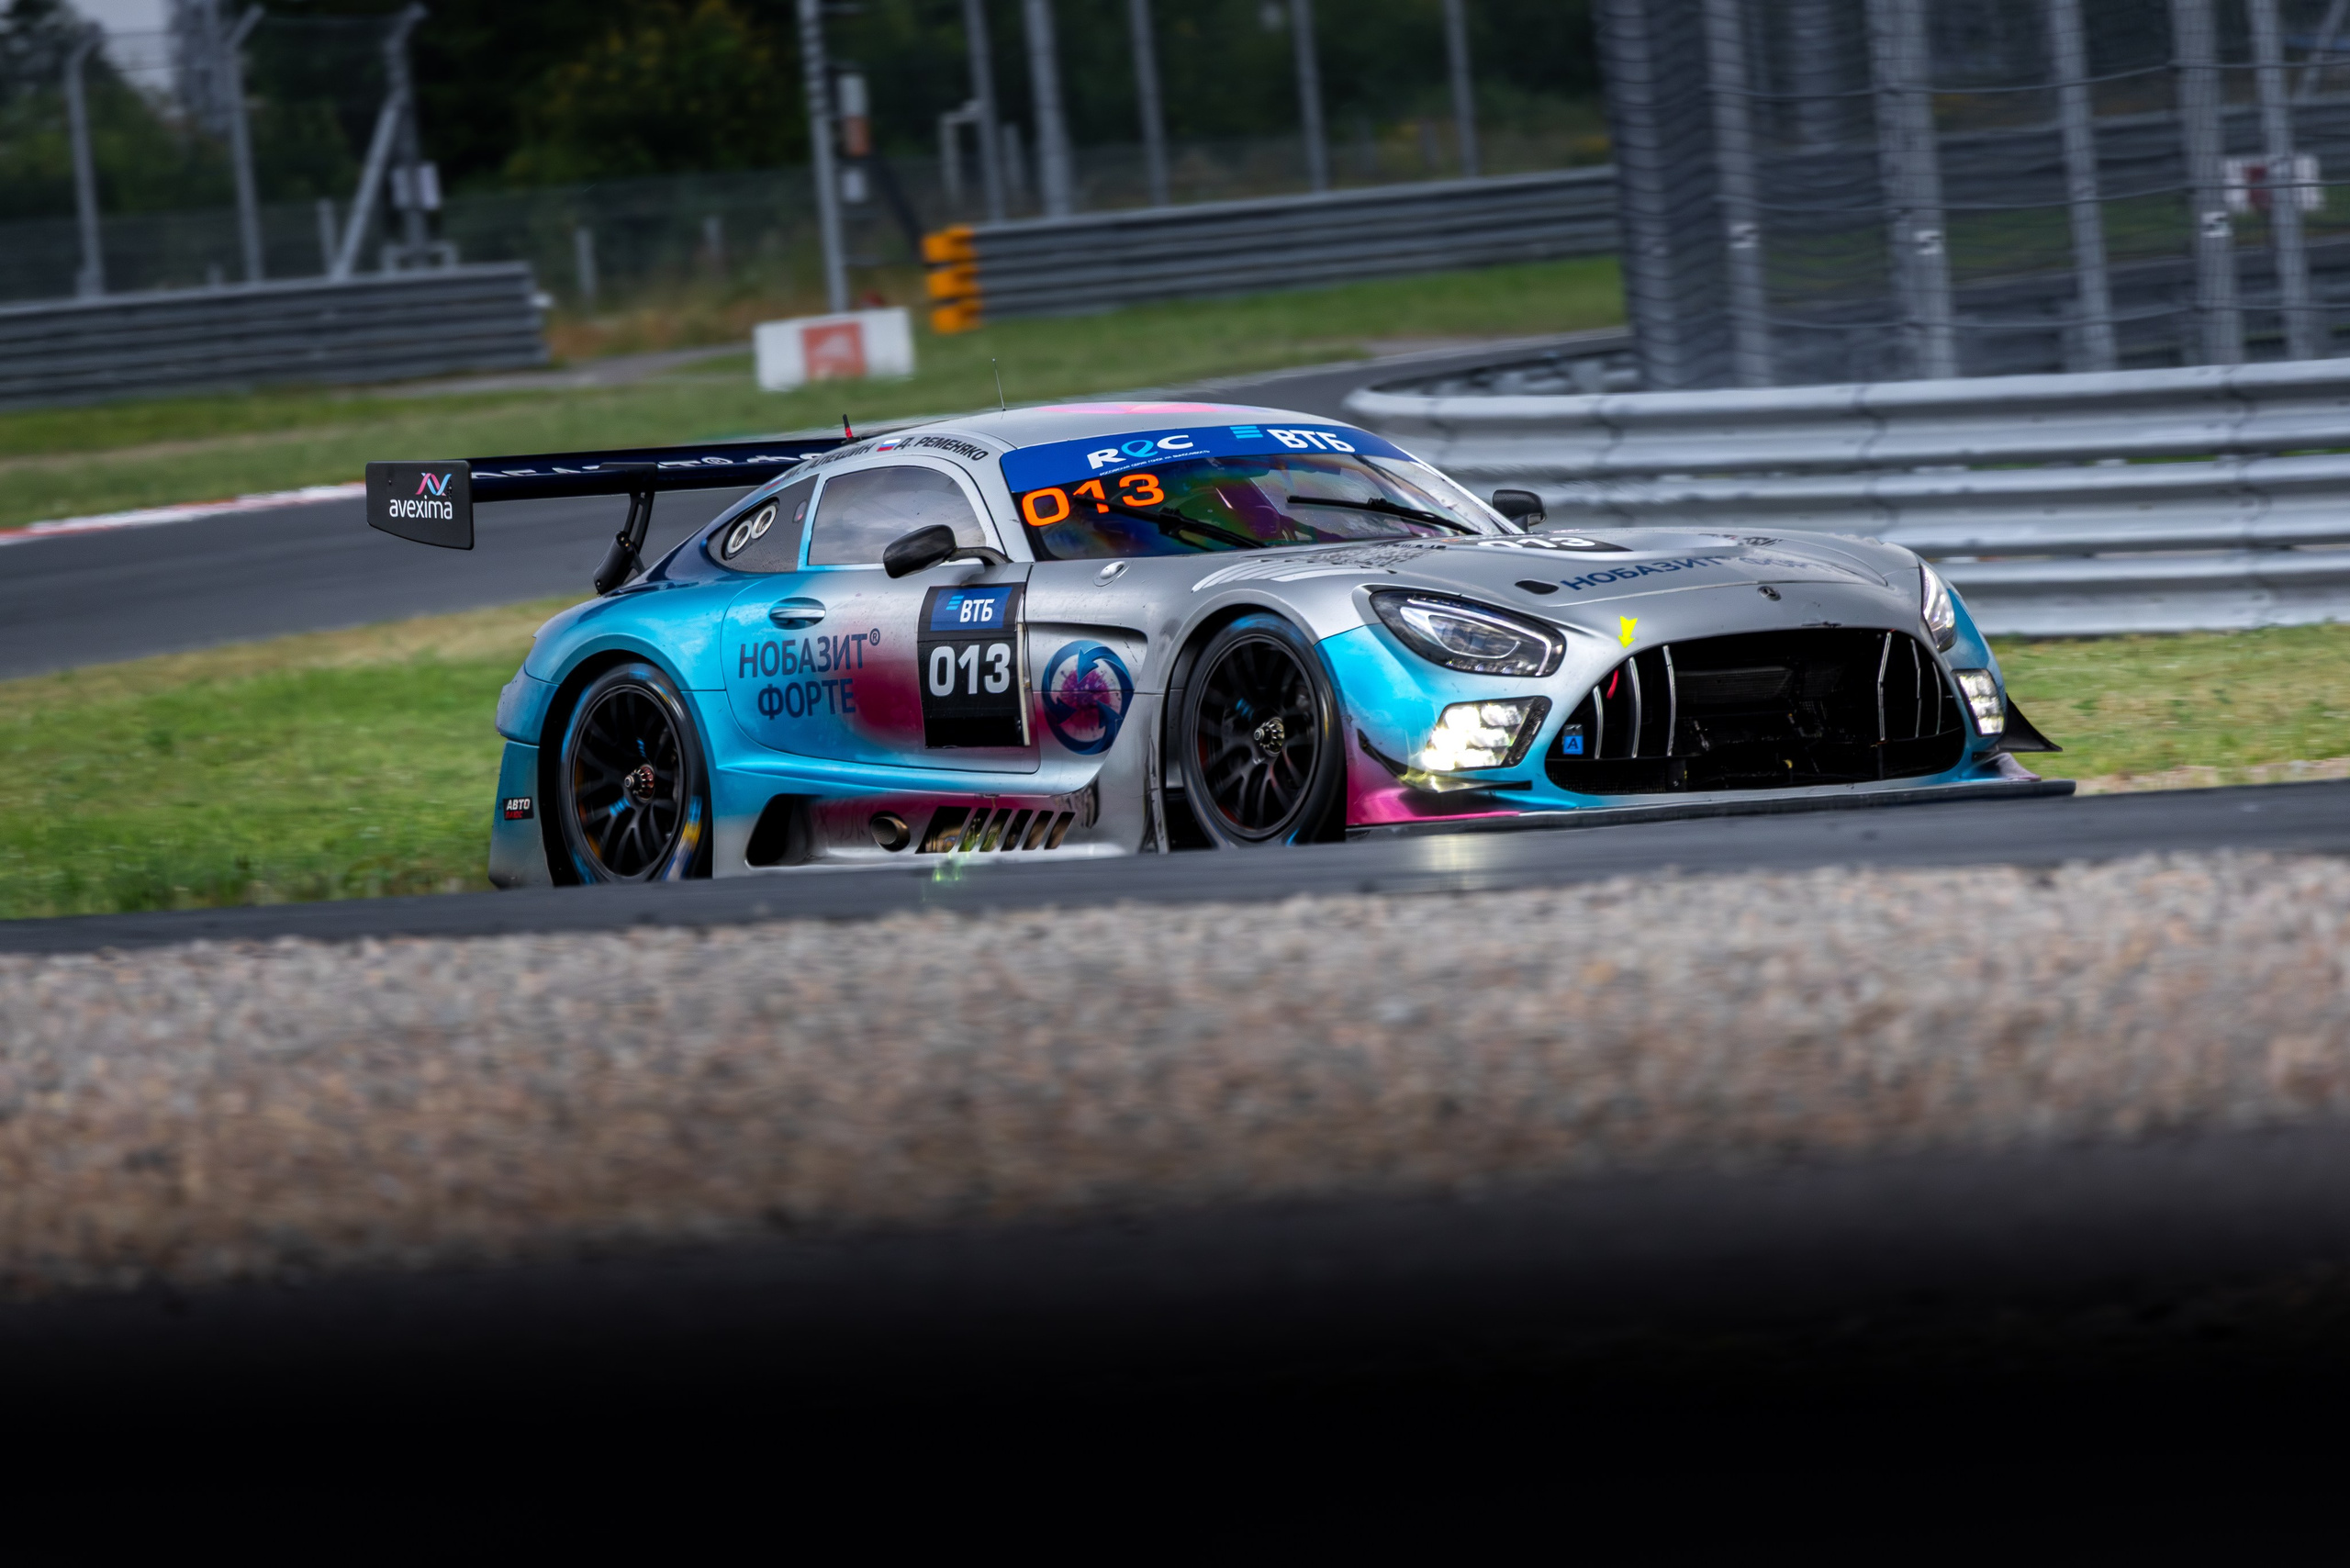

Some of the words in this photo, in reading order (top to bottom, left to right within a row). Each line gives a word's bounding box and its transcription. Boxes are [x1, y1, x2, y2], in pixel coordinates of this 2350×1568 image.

[893, 436, 915, 450] Д.
[913, 436, 989, 461] РЕМЕНЯКО
[1267, 429, 1356, 453] ВТБ
[389, 495, 453, 520] avexima
[1022, 474, 1165, 527] 013
[959, 599, 995, 623] ВТБ
[929, 643, 1011, 697] 013
[757, 678, 856, 721] ФОРТЕ
[506, 798, 531, 811] АВТО
